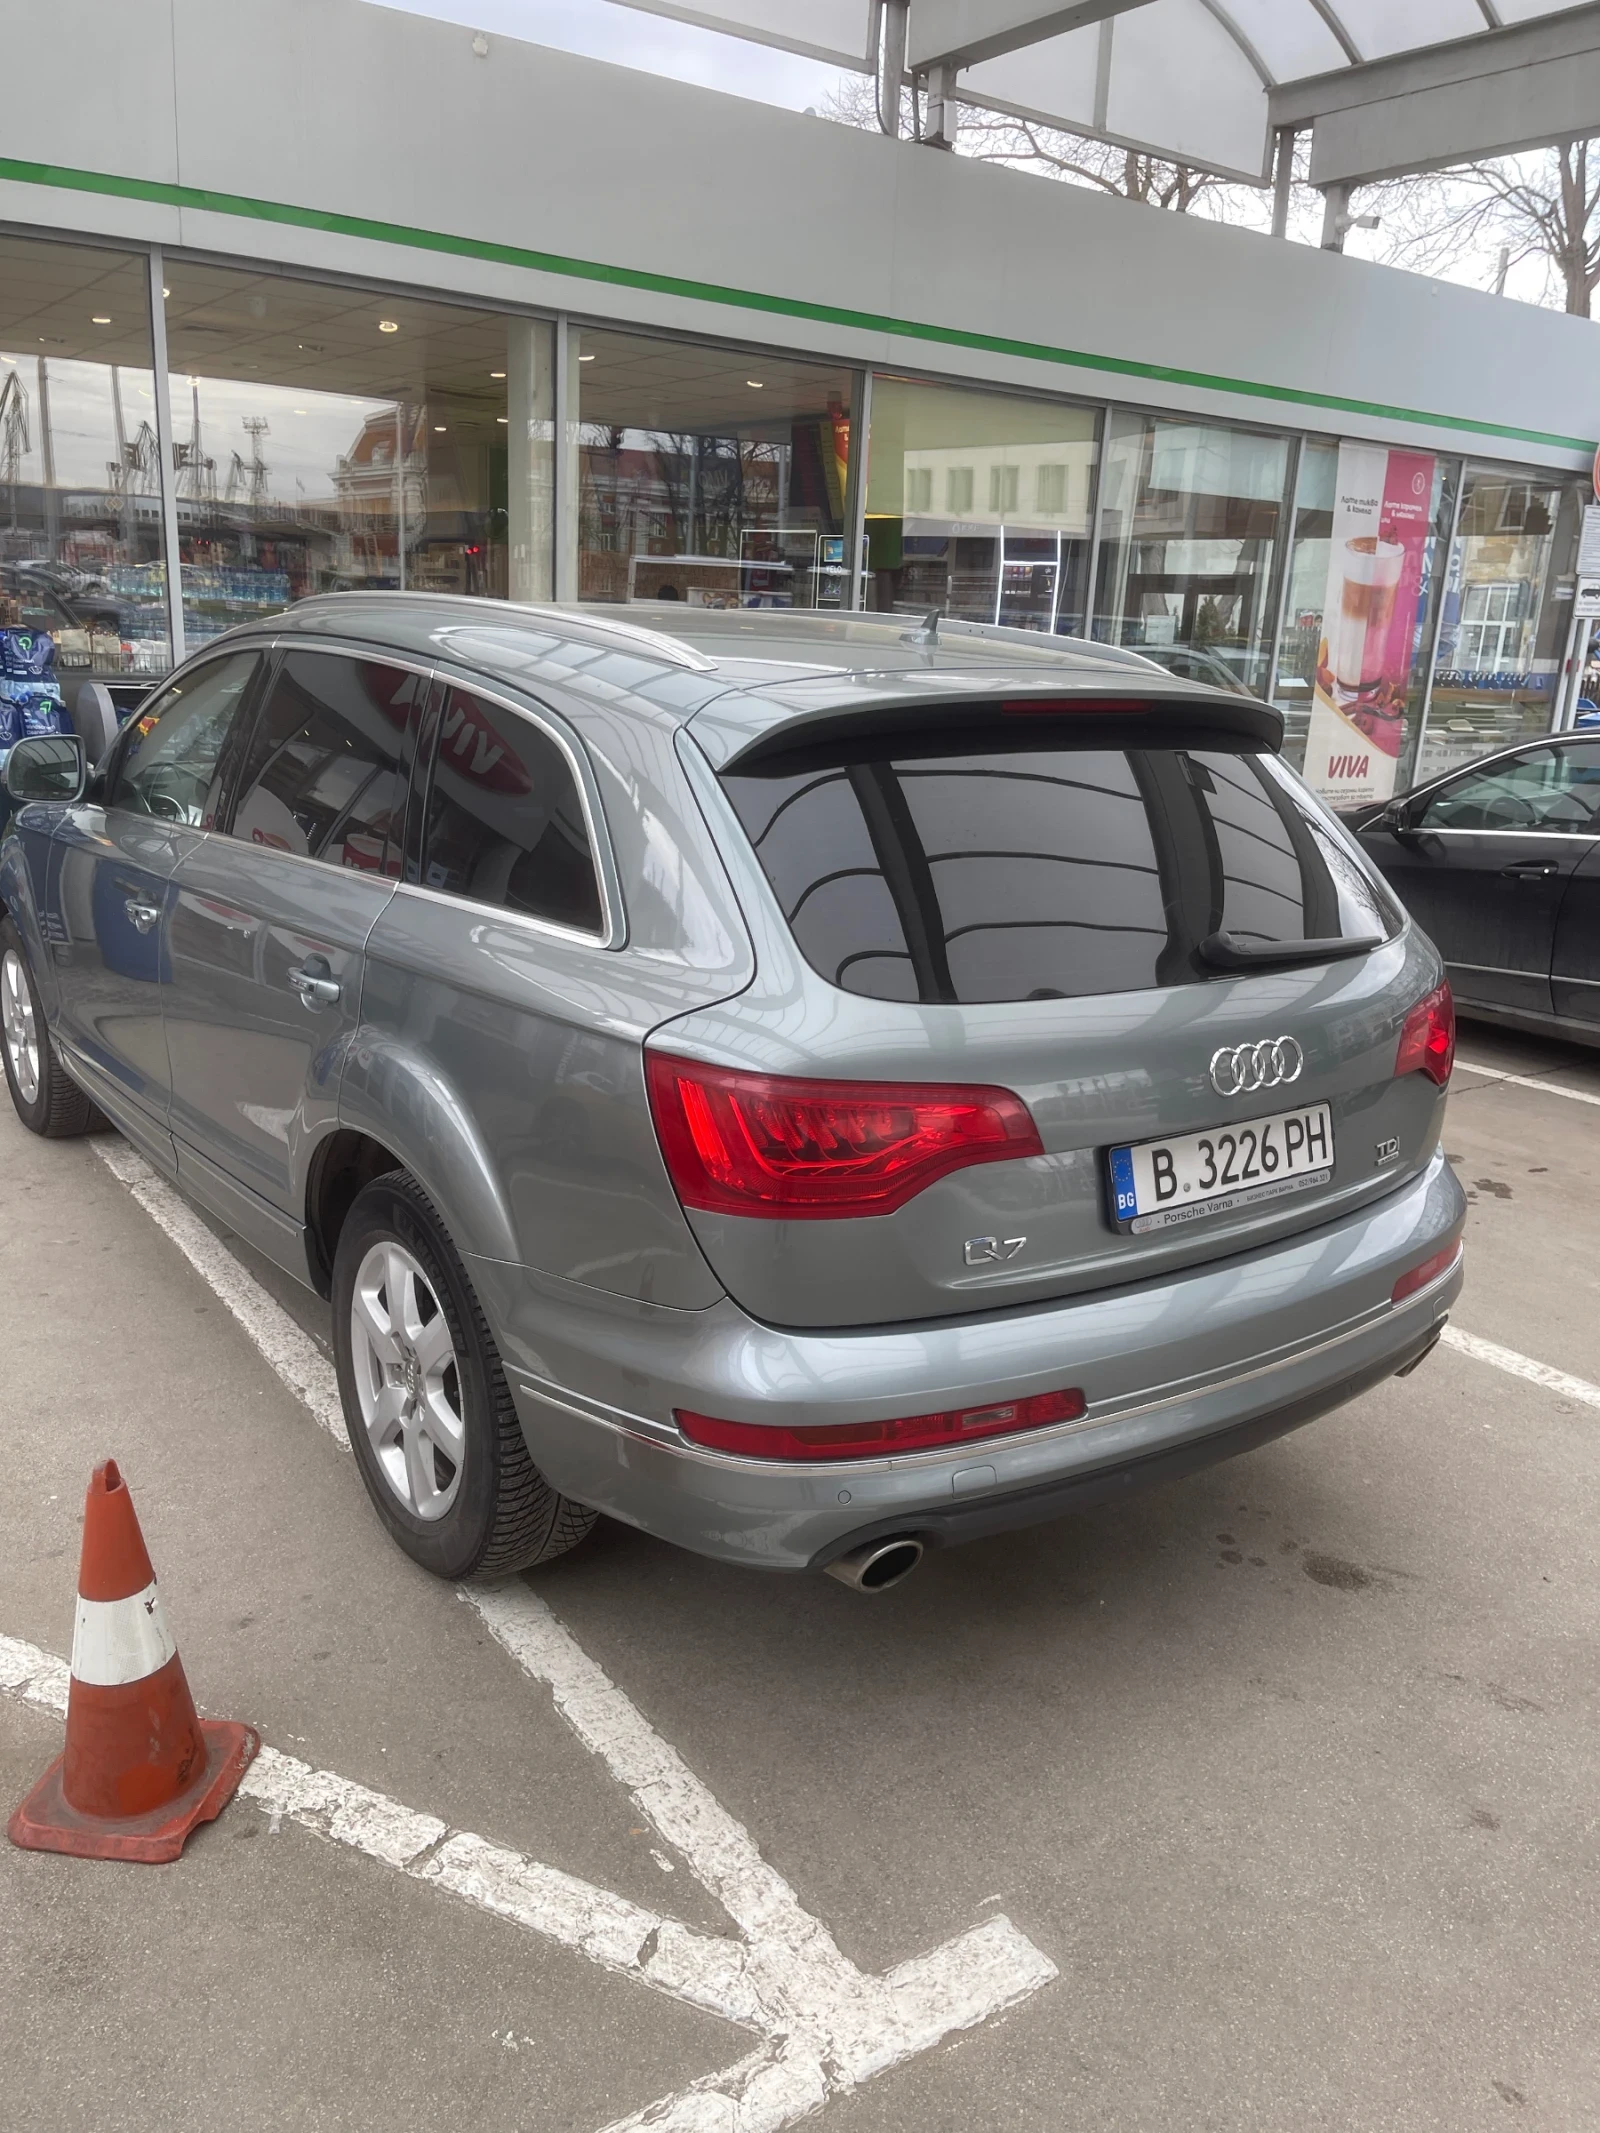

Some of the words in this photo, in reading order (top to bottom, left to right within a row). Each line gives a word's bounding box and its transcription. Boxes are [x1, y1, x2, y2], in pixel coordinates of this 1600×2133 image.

[1328, 755, 1369, 778] VIVA
[1151, 1148, 1178, 1202] B
[1198, 1124, 1279, 1189] 3226
[1284, 1112, 1328, 1168] PH
[1376, 1136, 1400, 1157] TDI
[1118, 1192, 1135, 1210] BG
[1246, 1191, 1265, 1201] БИЗНЕС
[1266, 1187, 1279, 1197] ПАРК
[1163, 1205, 1205, 1224] Porsche
[1207, 1198, 1233, 1213] Varna
[965, 1236, 1026, 1265] Q7
